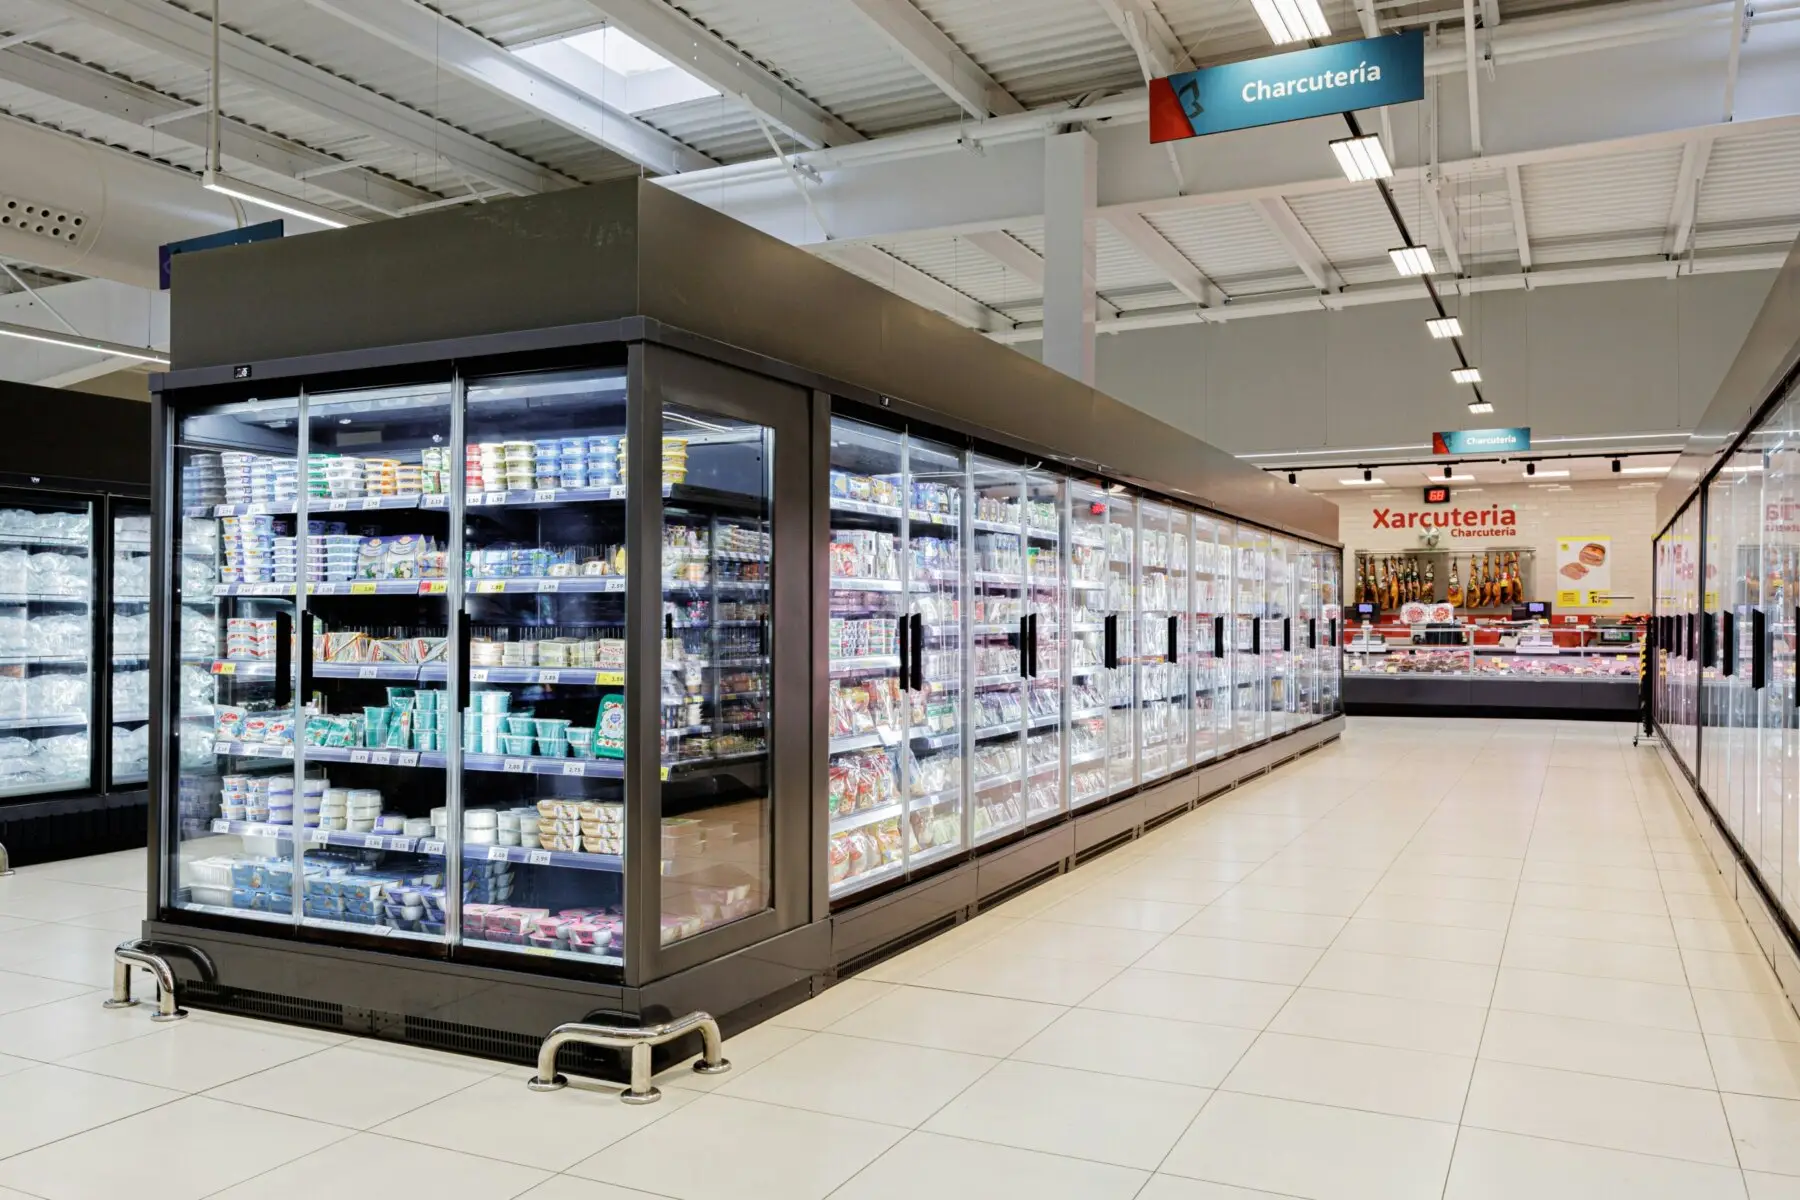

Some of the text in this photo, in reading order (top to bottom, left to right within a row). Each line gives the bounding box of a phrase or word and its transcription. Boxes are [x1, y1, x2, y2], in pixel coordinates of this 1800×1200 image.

[1241, 60, 1381, 103] Charcutería
[1429, 489, 1445, 501] 68
[1372, 503, 1517, 529] Xarcuteria
